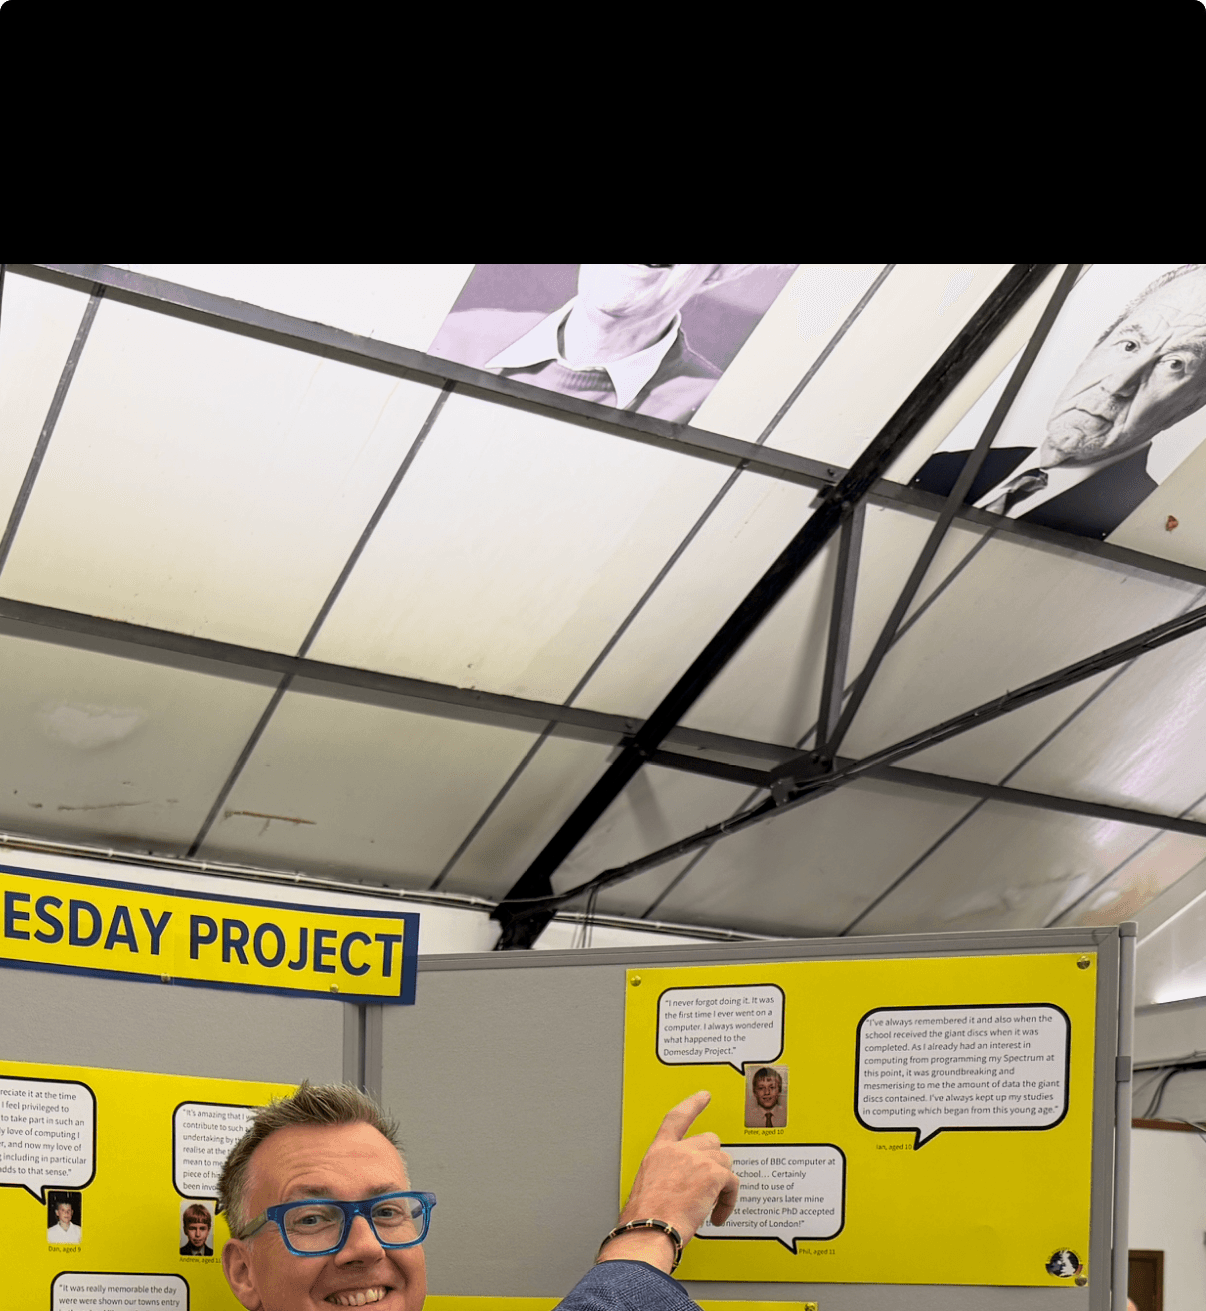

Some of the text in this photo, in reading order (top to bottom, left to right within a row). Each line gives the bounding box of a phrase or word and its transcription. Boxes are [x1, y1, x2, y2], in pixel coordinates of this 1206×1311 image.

[4, 891, 402, 977] ESDAY PROJECT
[708, 1023, 733, 1032] always
[735, 1020, 774, 1029] wondered
[684, 1034, 722, 1044] happened
[865, 1031, 892, 1039] school
[893, 1030, 927, 1038] received
[944, 1030, 965, 1039] giant
[864, 1057, 908, 1066] computing
[910, 1056, 929, 1064] from
[931, 1055, 987, 1065] programming
[989, 1056, 1002, 1064] my
[1004, 1054, 1044, 1063] Spectrum
[931, 1068, 997, 1078] groundbreaking
[6, 1100, 20, 1110] feel
[22, 1103, 60, 1113] privileged
[183, 1122, 218, 1130] contribute
[7, 1127, 23, 1136] love
[34, 1130, 76, 1140] computing
[56, 1143, 72, 1151] love
[760, 1157, 768, 1165] of
[788, 1158, 825, 1167] computer
[740, 1196, 761, 1204] many
[763, 1196, 783, 1204] years
[99, 1297, 122, 1305] shown
[161, 1299, 180, 1307] entry
